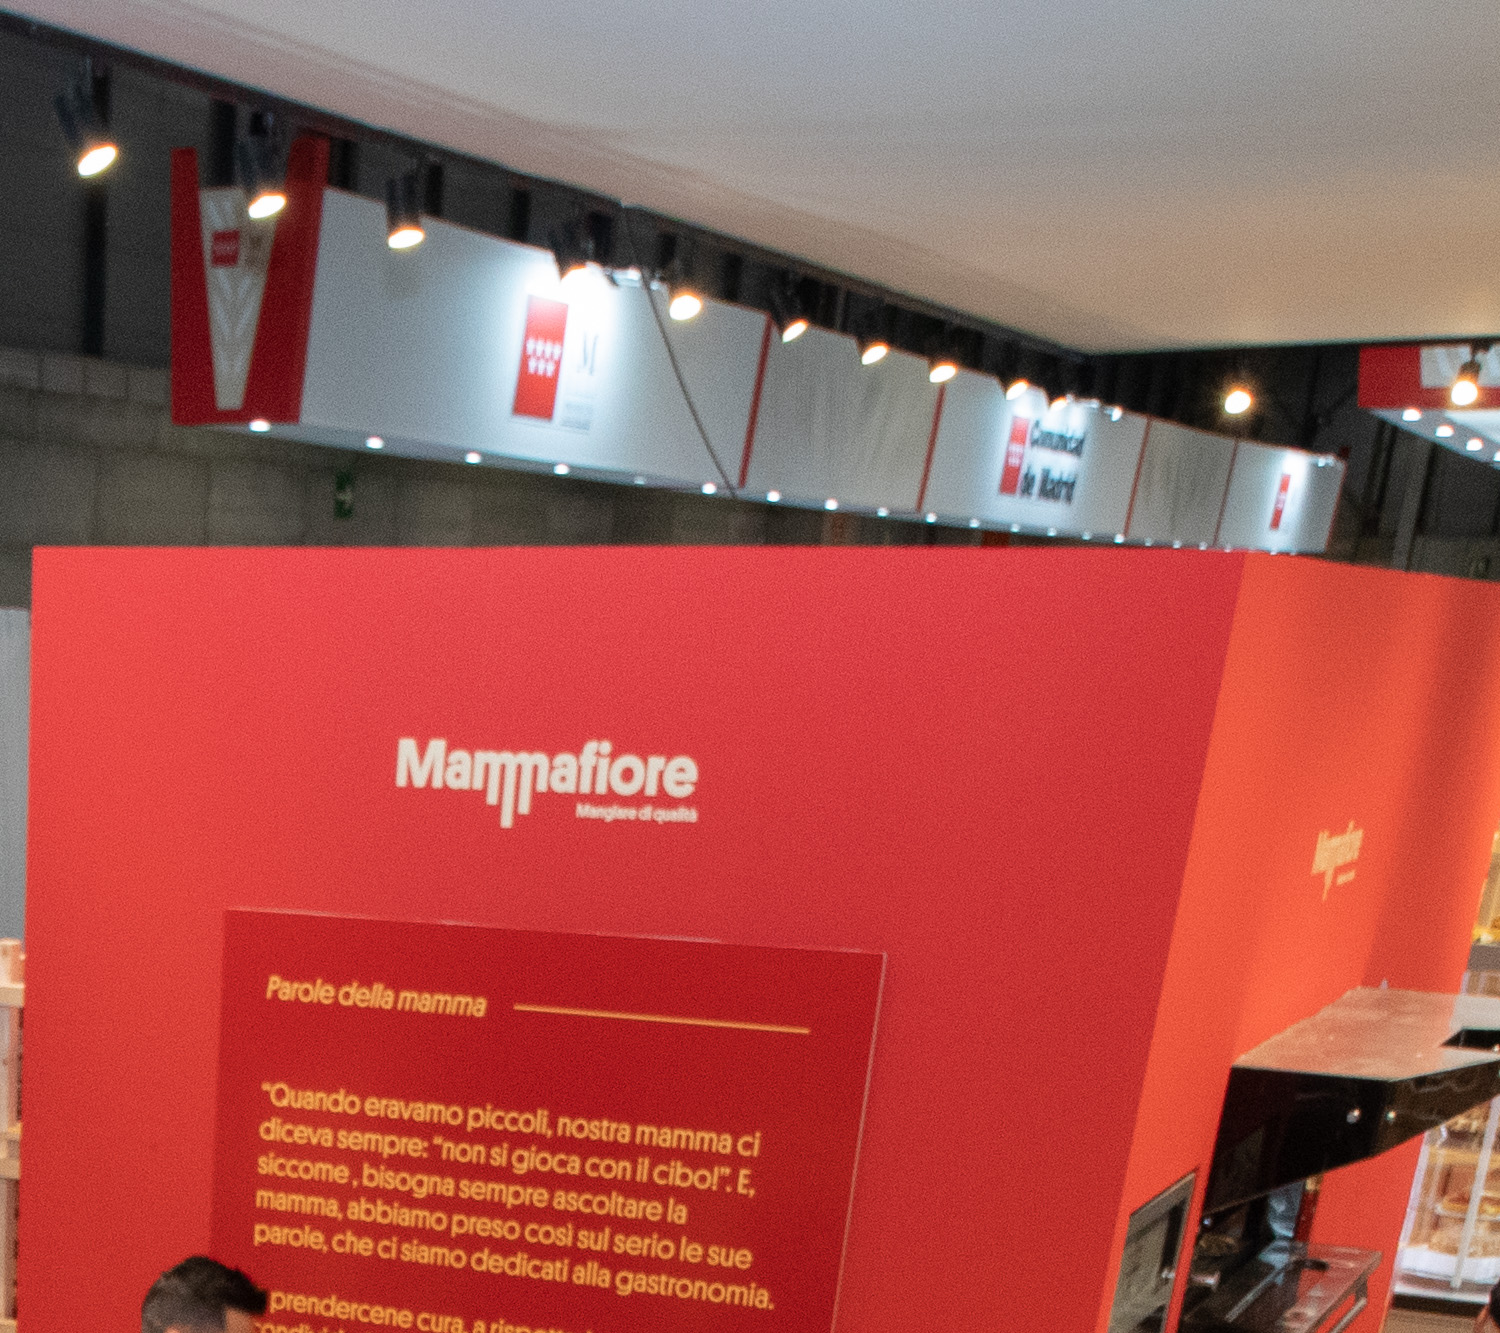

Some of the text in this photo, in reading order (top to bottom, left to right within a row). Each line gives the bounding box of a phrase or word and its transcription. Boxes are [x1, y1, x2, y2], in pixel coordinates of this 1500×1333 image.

[265, 974, 488, 1018] Parole della mamma
[259, 1117, 333, 1147] diceva
[337, 1130, 428, 1158] sempre:
[490, 1144, 507, 1166] si
[512, 1147, 580, 1174] gioca
[585, 1158, 631, 1180] con
[636, 1158, 649, 1182] il
[738, 1169, 754, 1196] E,
[364, 1097, 463, 1125] eravamo
[467, 1105, 552, 1137] piccoli,
[558, 1117, 631, 1143] nostra
[636, 1125, 732, 1153] mamma
[737, 1132, 760, 1156] ci
[258, 1153, 350, 1184] siccome
[362, 1163, 455, 1198] bisogna
[459, 1180, 549, 1208] sempre
[553, 1191, 663, 1221] ascoltare
[667, 1198, 687, 1224] la
[256, 1190, 343, 1219] mamma,
[347, 1198, 448, 1230] abbiamo
[452, 1215, 520, 1239] preso
[578, 1228, 610, 1250] sul
[614, 1234, 675, 1259] serio
[680, 1237, 703, 1262] le
[707, 1246, 752, 1269] sue
[254, 1224, 773, 1309] parole, che ci siamo dedicati alla gastronomia.
[270, 1292, 413, 1328] prendercene
